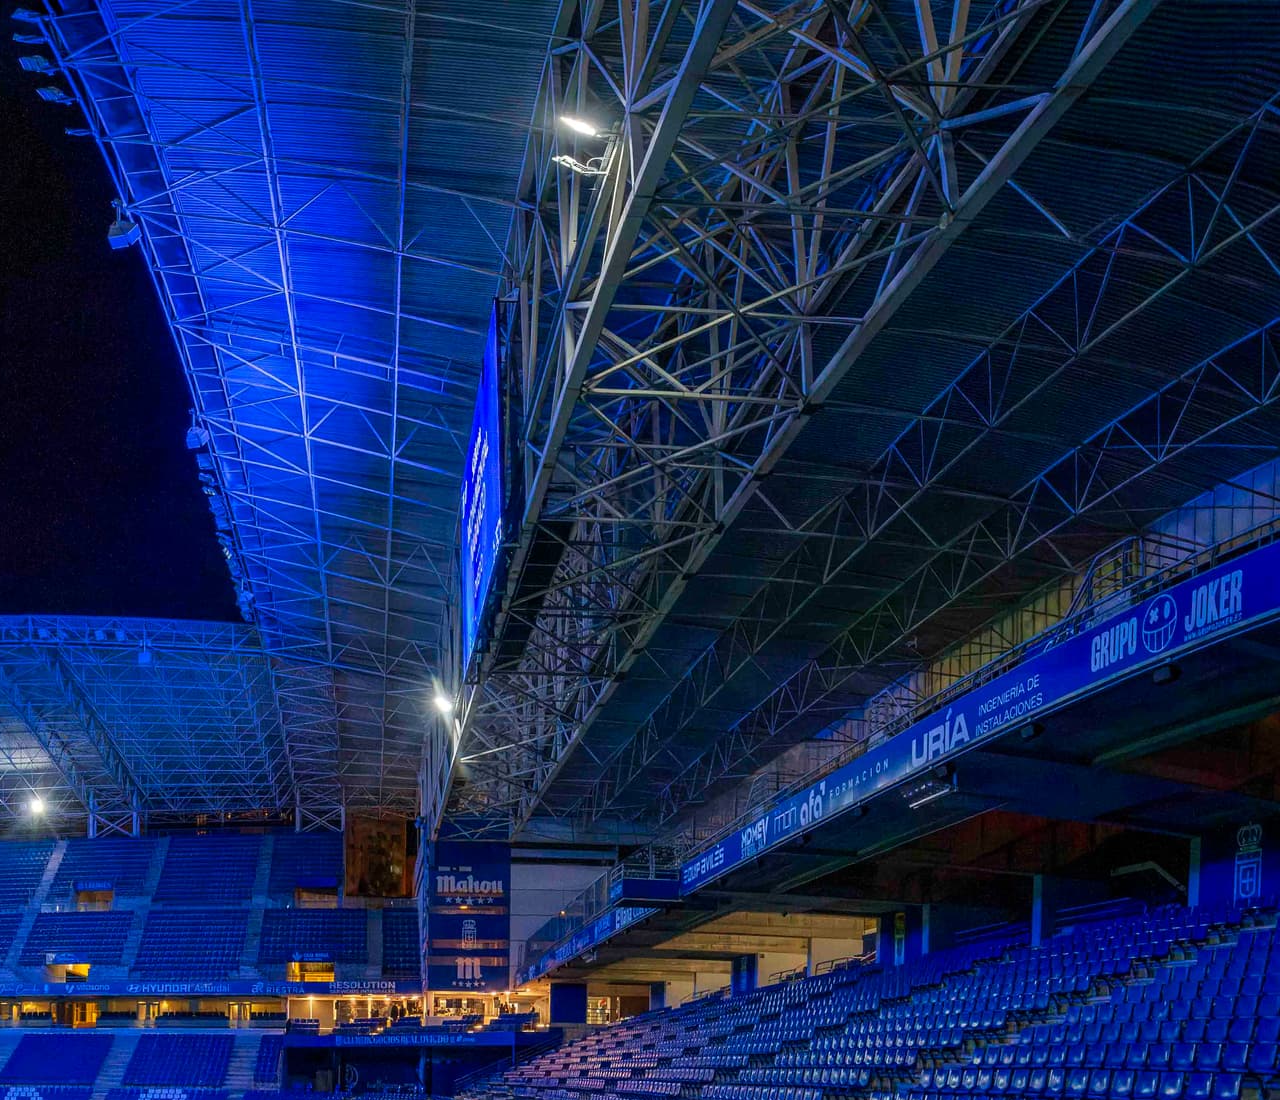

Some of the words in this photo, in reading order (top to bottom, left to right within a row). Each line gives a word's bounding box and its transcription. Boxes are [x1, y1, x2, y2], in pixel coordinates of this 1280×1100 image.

[1090, 616, 1138, 673] GRUPO
[1183, 568, 1243, 633] JOKER
[975, 693, 1044, 737] INSTALACIONES
[978, 680, 1026, 717] INGENIERÍA
[1026, 673, 1041, 691] DE
[911, 707, 971, 769] URÍA
[435, 875, 504, 894] Mahou
[142, 983, 190, 993] HYUNDAI
[329, 981, 396, 990] RESOLUTION
